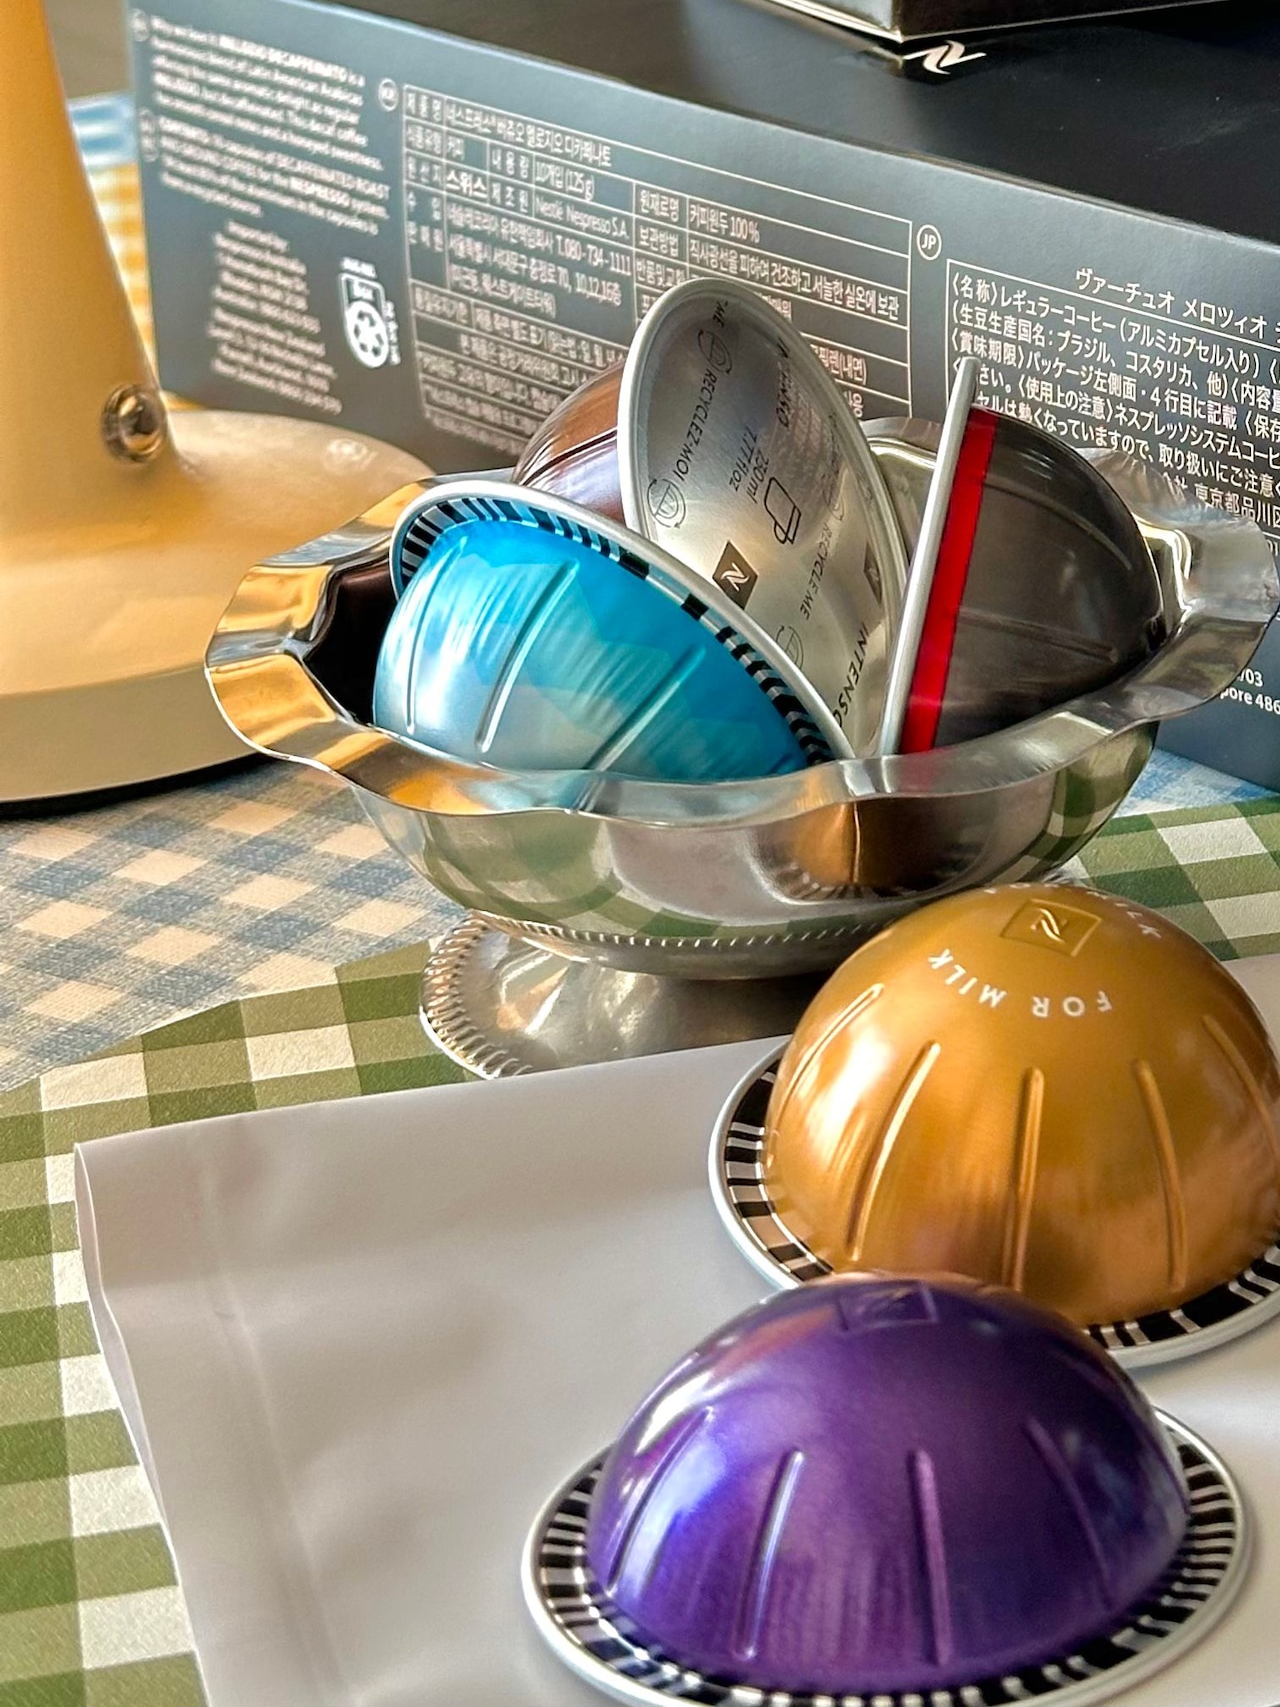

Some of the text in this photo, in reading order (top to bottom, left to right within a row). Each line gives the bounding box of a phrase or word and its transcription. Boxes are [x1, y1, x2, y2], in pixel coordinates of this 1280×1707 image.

[689, 202, 761, 243] 커피원두 100%
[689, 238, 900, 321] 직사광선을 피하여 건조하고 서늘한 실온에 보관
[1075, 268, 1176, 315] ヴァーチュオ
[1182, 285, 1268, 339] メロツィオ
[672, 368, 718, 482] RECYCLEZ-MOI
[928, 948, 1113, 1018] FOR MILK
